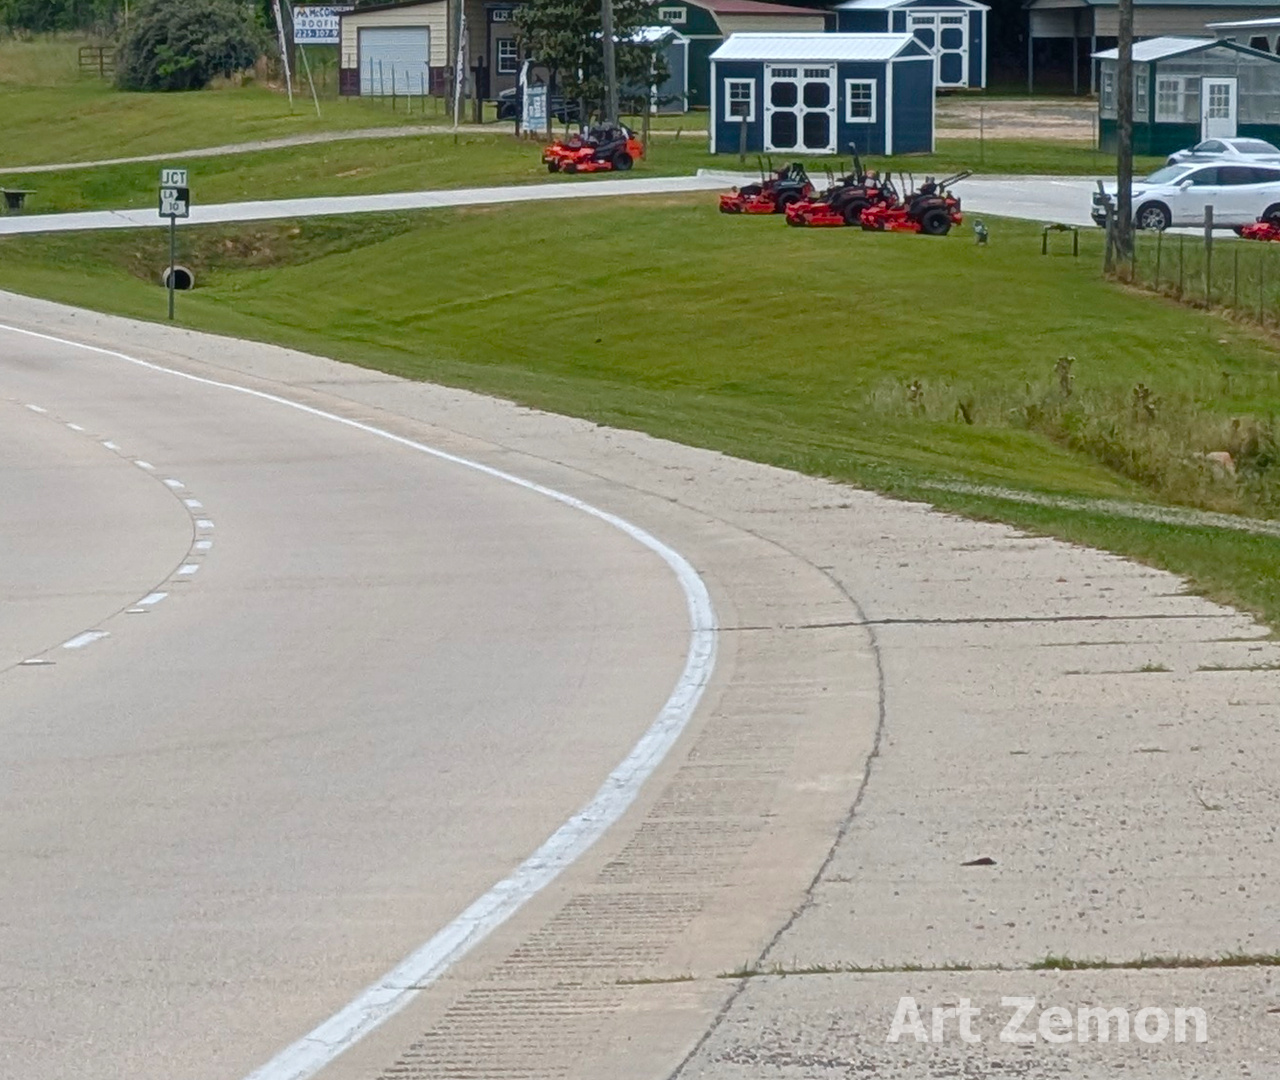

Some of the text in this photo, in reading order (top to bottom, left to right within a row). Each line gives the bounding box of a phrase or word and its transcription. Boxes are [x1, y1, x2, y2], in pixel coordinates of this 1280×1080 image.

[162, 171, 185, 185] JCT
[163, 191, 174, 199] LA
[169, 202, 179, 211] 10
